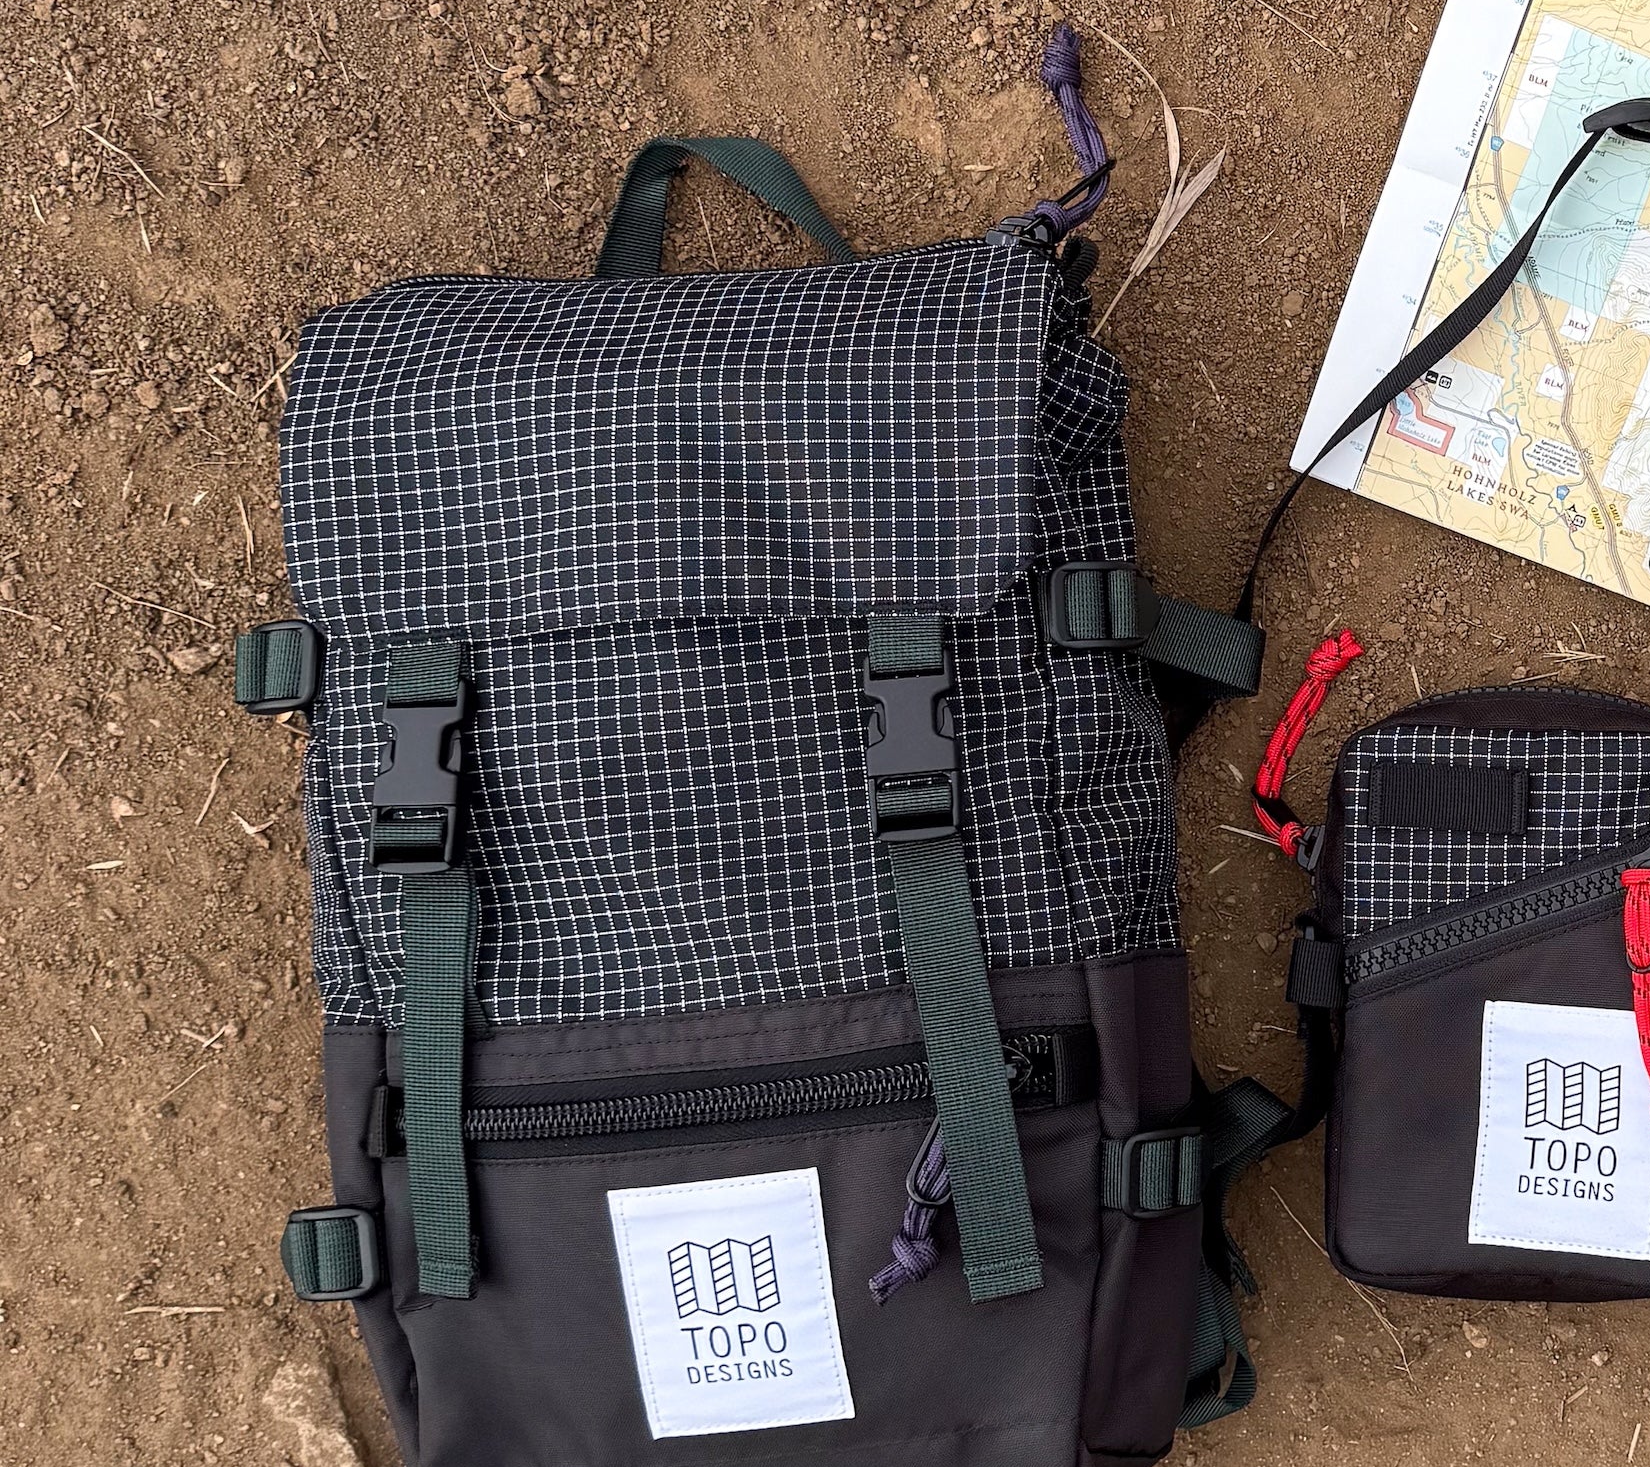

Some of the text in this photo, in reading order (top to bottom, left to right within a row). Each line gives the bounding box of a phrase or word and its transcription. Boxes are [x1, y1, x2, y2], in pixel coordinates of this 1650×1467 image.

[1527, 73, 1549, 87] BLM
[1446, 480, 1531, 520] LAKES SWA
[1451, 465, 1537, 506] HOHNHOLZ
[1524, 1136, 1617, 1177] TOPO
[1518, 1174, 1615, 1202] DESIGNS
[681, 1321, 788, 1361] TOPO
[687, 1359, 794, 1385] DESIGNS
